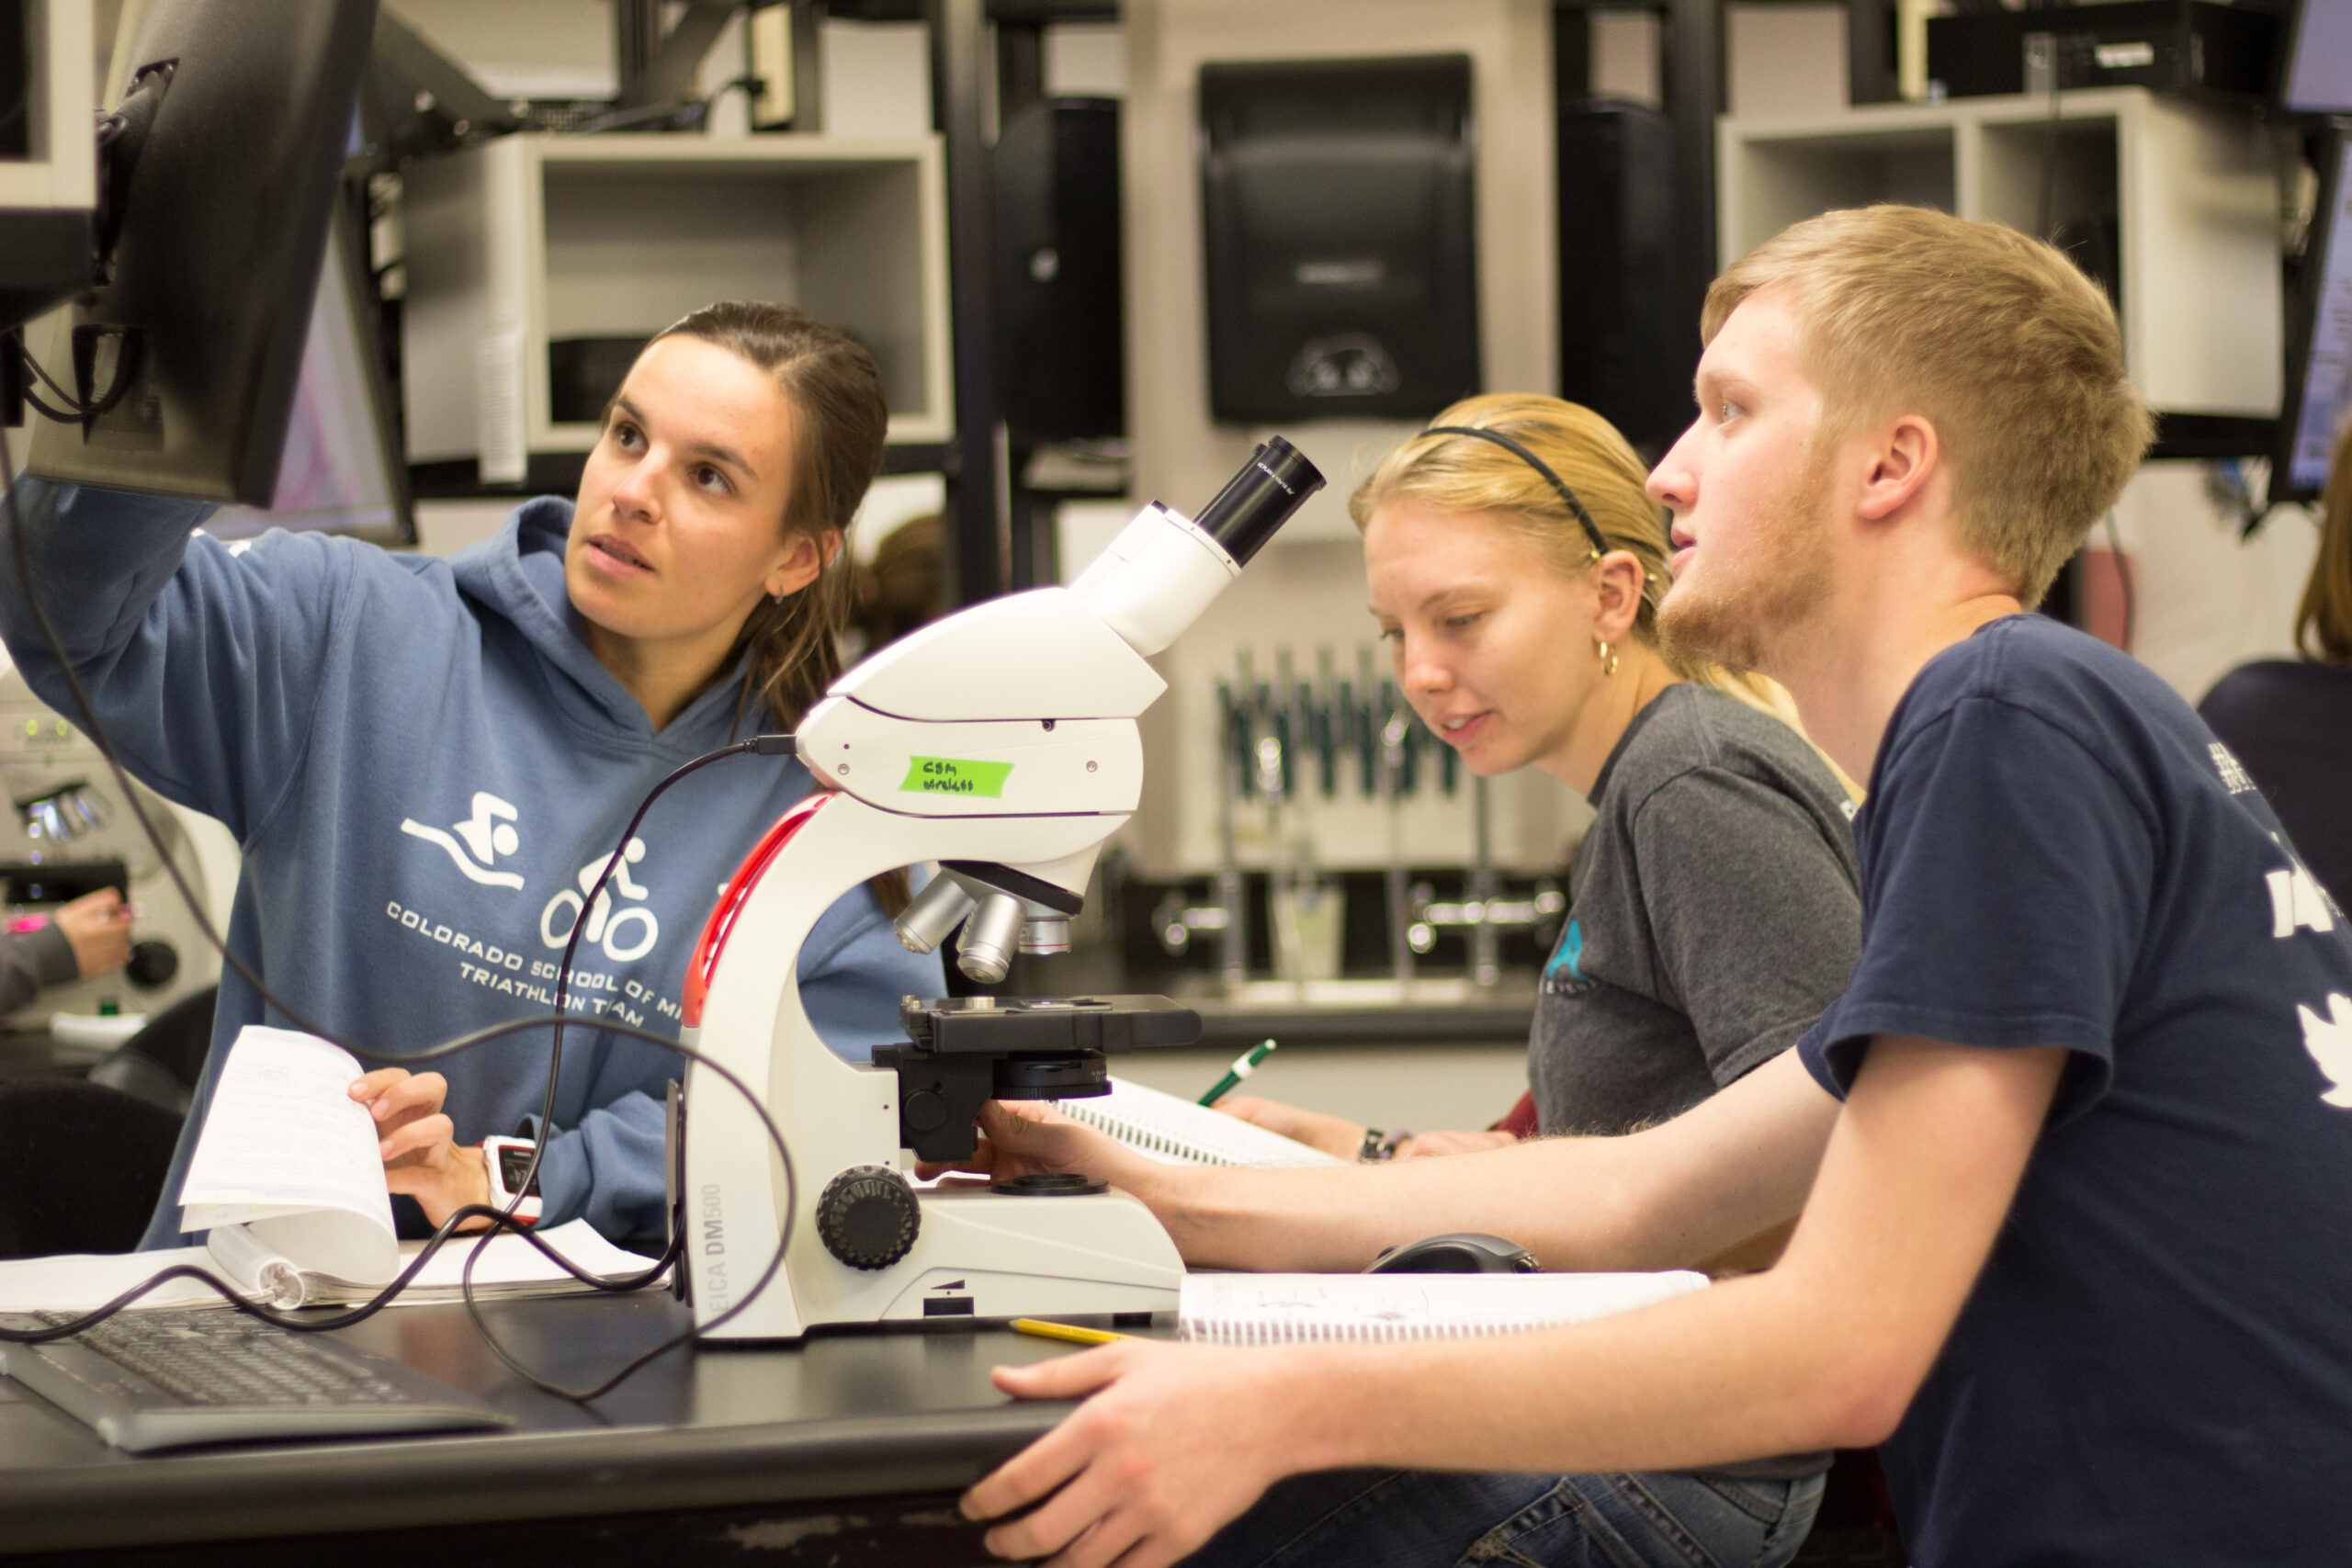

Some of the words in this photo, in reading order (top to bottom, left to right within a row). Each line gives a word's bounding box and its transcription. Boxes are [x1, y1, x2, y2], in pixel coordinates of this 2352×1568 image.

[386, 900, 524, 971] COLORADO
[530, 960, 619, 993] SCHOOL
[625, 979, 655, 1004] OF
[656, 997, 683, 1021] MI
[460, 962, 587, 1012] TRIATHLON
[593, 997, 645, 1028] TAM
[701, 1184, 725, 1256] DM500
[707, 1262, 729, 1314] EICA
